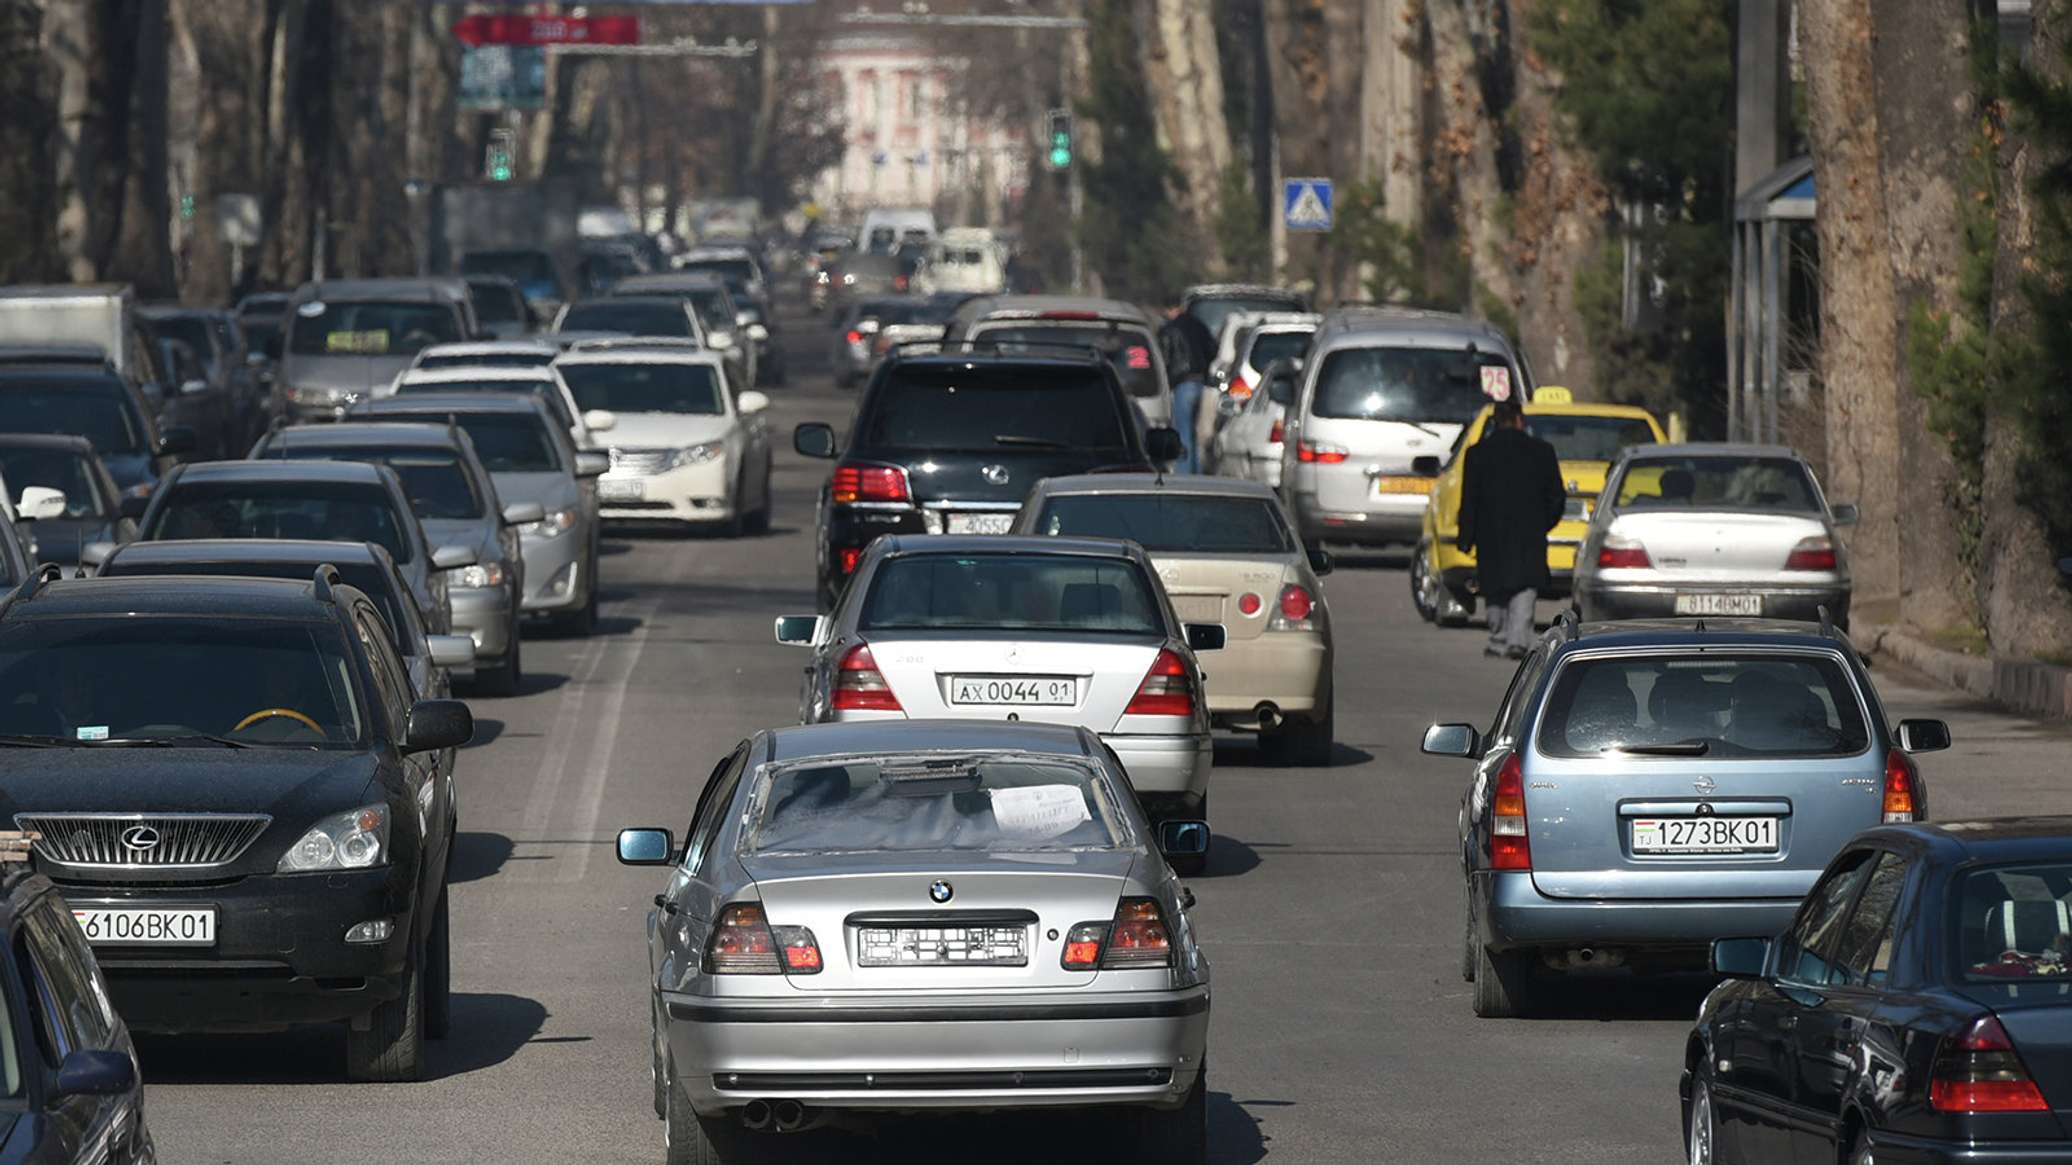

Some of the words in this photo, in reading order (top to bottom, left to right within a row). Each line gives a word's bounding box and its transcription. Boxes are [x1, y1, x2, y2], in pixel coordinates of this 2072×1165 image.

[1482, 366, 1508, 398] 25
[987, 681, 1040, 701] 0044
[1048, 682, 1069, 696] 01
[1639, 835, 1653, 846] TJ
[1658, 820, 1770, 845] 1273BK01
[86, 912, 208, 939] 6106BK01
